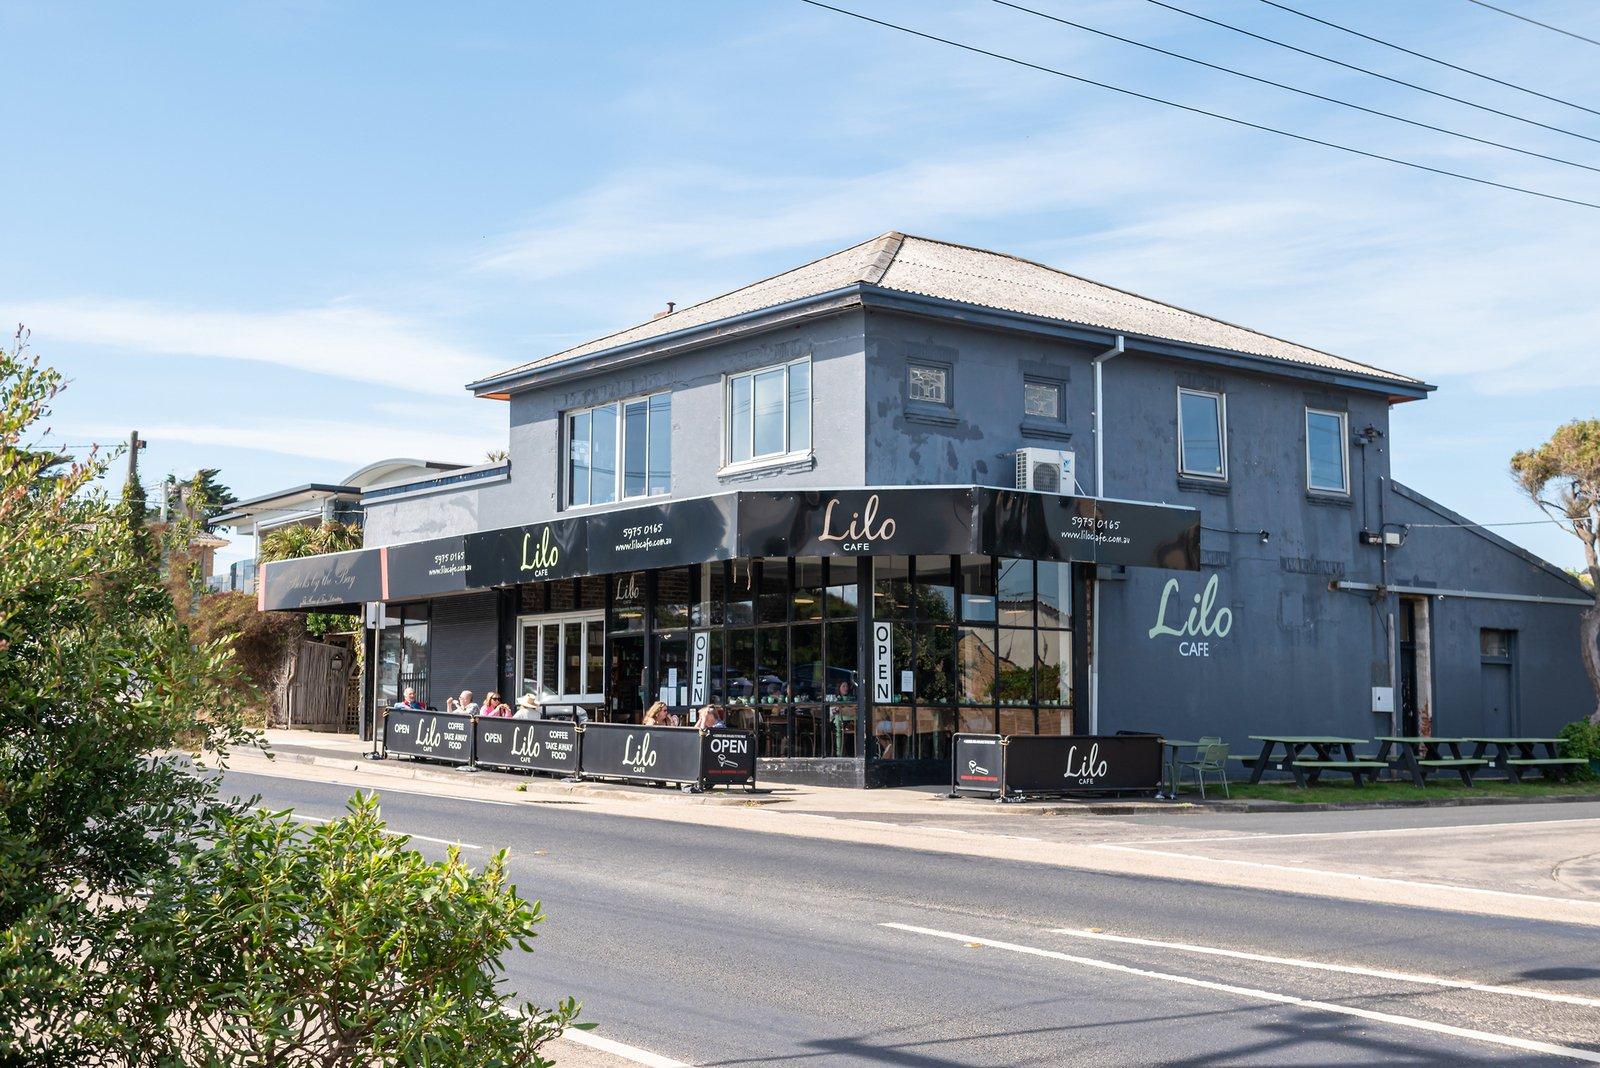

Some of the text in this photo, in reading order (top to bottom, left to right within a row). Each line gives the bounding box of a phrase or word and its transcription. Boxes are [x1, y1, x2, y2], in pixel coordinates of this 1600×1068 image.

[818, 494, 896, 541] Lilo
[1071, 516, 1120, 530] 5975 0165
[623, 523, 663, 539] 5975 0165
[1061, 530, 1131, 545] www.lilocafe.com.au
[520, 526, 559, 571] Lilo
[615, 537, 672, 551] www.lilocafe.com.au
[843, 543, 870, 551] CAFE
[434, 551, 465, 565] 5975 0165
[534, 569, 548, 577] CAFE
[615, 575, 640, 601] Lilo
[1148, 573, 1233, 639] Lilo
[1179, 642, 1209, 657] CAFE
[694, 636, 706, 702] OPEN
[876, 626, 890, 700] OPEN
[394, 723, 410, 734] OPEN
[415, 717, 441, 747] Lilo
[447, 722, 465, 731] COFFEE
[443, 732, 468, 742] TAKE AWAY
[484, 732, 502, 744] OPEN
[511, 725, 541, 758] Lilo
[549, 730, 569, 740] COFFEE
[448, 741, 462, 750] FOOD
[545, 741, 574, 752] TAKE AWAY
[622, 732, 657, 767] Lilo
[710, 738, 748, 754] OPEN
[520, 756, 531, 764] CAFE
[551, 751, 567, 760] FOOD
[1063, 742, 1108, 778] Lilo
[633, 766, 646, 774] CAFE
